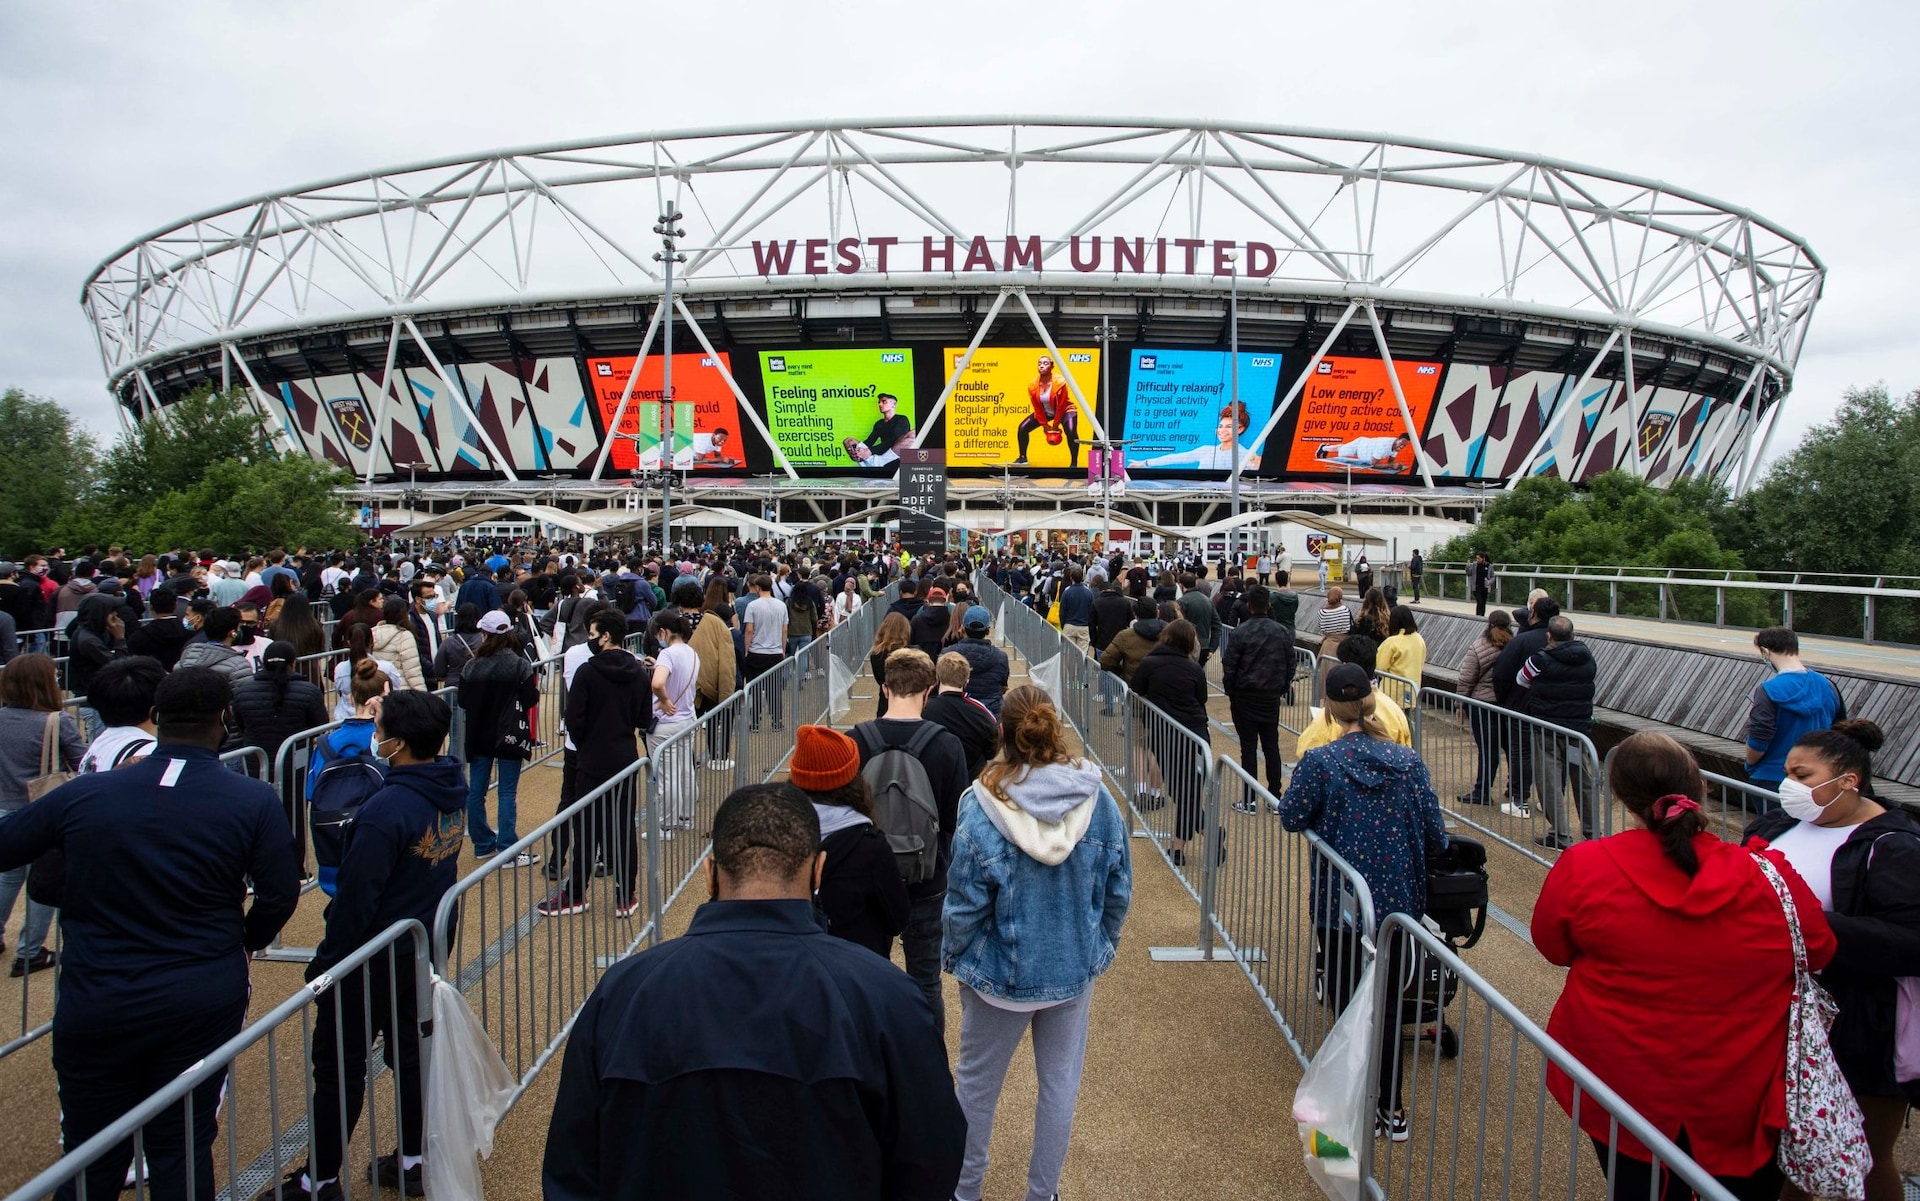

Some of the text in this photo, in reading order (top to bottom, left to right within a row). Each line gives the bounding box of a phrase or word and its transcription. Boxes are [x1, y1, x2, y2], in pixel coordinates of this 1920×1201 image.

[751, 235, 1277, 278] WEST HAM UNITED
[882, 354, 903, 362] NHS
[1069, 354, 1091, 362] NHS
[1253, 358, 1273, 366] NHS
[1417, 366, 1435, 374] NHS
[955, 380, 989, 391] Trouble
[1136, 382, 1225, 395] Difficulty relaxing?
[772, 384, 876, 401] Feeling anxious?
[954, 392, 1005, 404] focussing?
[1311, 386, 1385, 403] Low energy?
[1135, 394, 1209, 407] Physical activity
[774, 400, 816, 415] Simple
[954, 404, 1031, 416] Regular physical
[1133, 408, 1141, 417] is
[1153, 408, 1177, 418] great
[1180, 410, 1199, 419] way
[1308, 402, 1347, 418] Getting
[1350, 403, 1382, 416] active
[776, 415, 833, 430] breathing
[954, 416, 988, 427] activity
[1132, 420, 1181, 429] to burn off
[1303, 417, 1395, 433] give you a boost.
[778, 429, 834, 442] exercises
[954, 427, 1008, 437] could make
[1131, 433, 1166, 442] nervous
[954, 439, 1011, 449] a difference.
[780, 443, 845, 460] could help.
